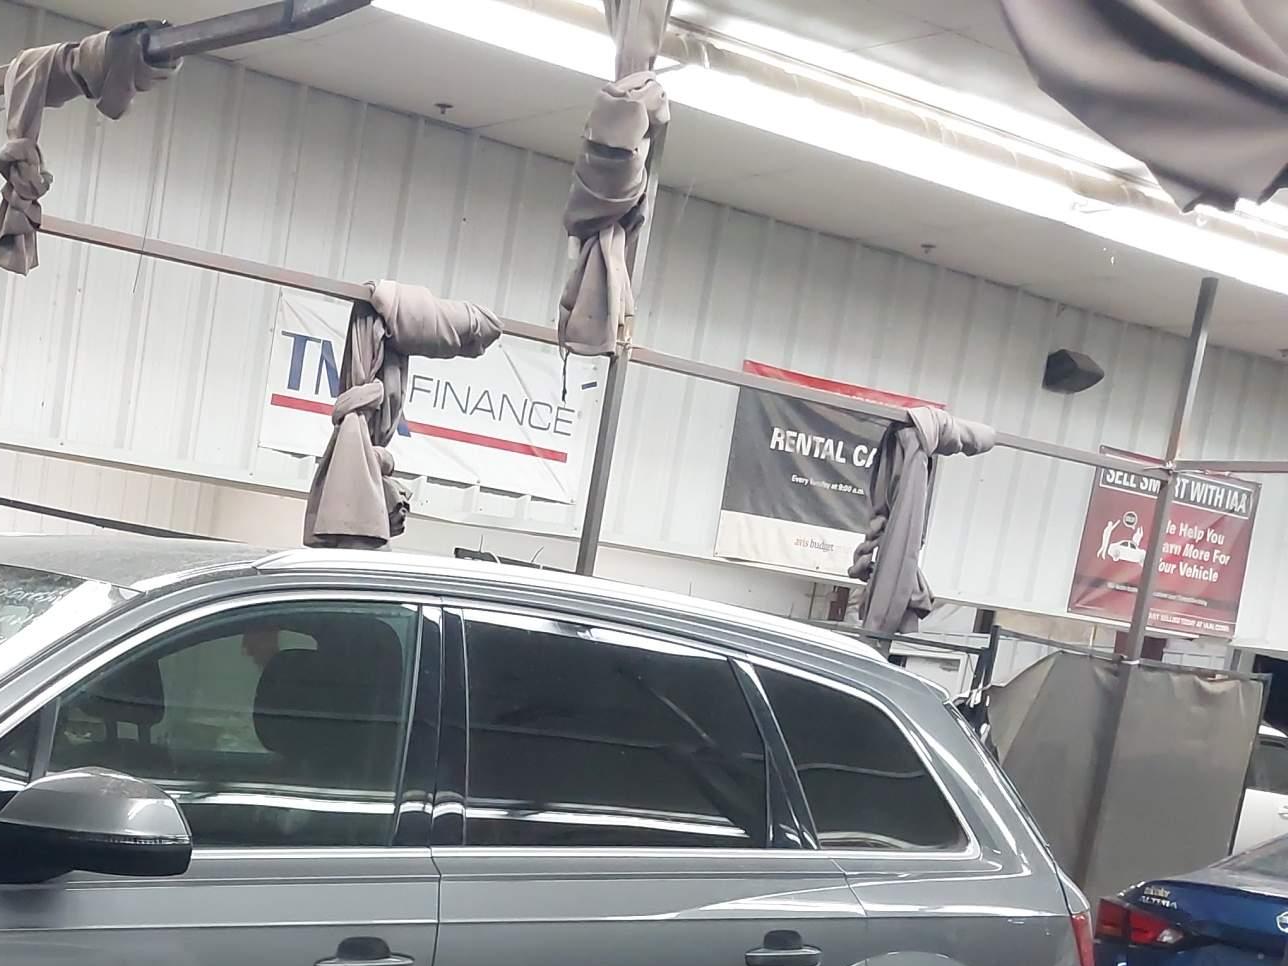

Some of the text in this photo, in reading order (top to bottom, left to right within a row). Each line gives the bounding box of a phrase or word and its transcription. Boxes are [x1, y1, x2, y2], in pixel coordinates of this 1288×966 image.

[409, 374, 575, 437] FINANCE
[769, 427, 878, 468] RENTAL CA
[791, 474, 809, 486] Every
[1106, 469, 1137, 488] SELL
[1190, 480, 1225, 508] WITH
[1225, 488, 1248, 514] IAA
[1166, 519, 1225, 545] e Help You
[809, 539, 835, 552] budget
[1162, 542, 1232, 566] arn More For
[1158, 558, 1219, 582] our Vehicle
